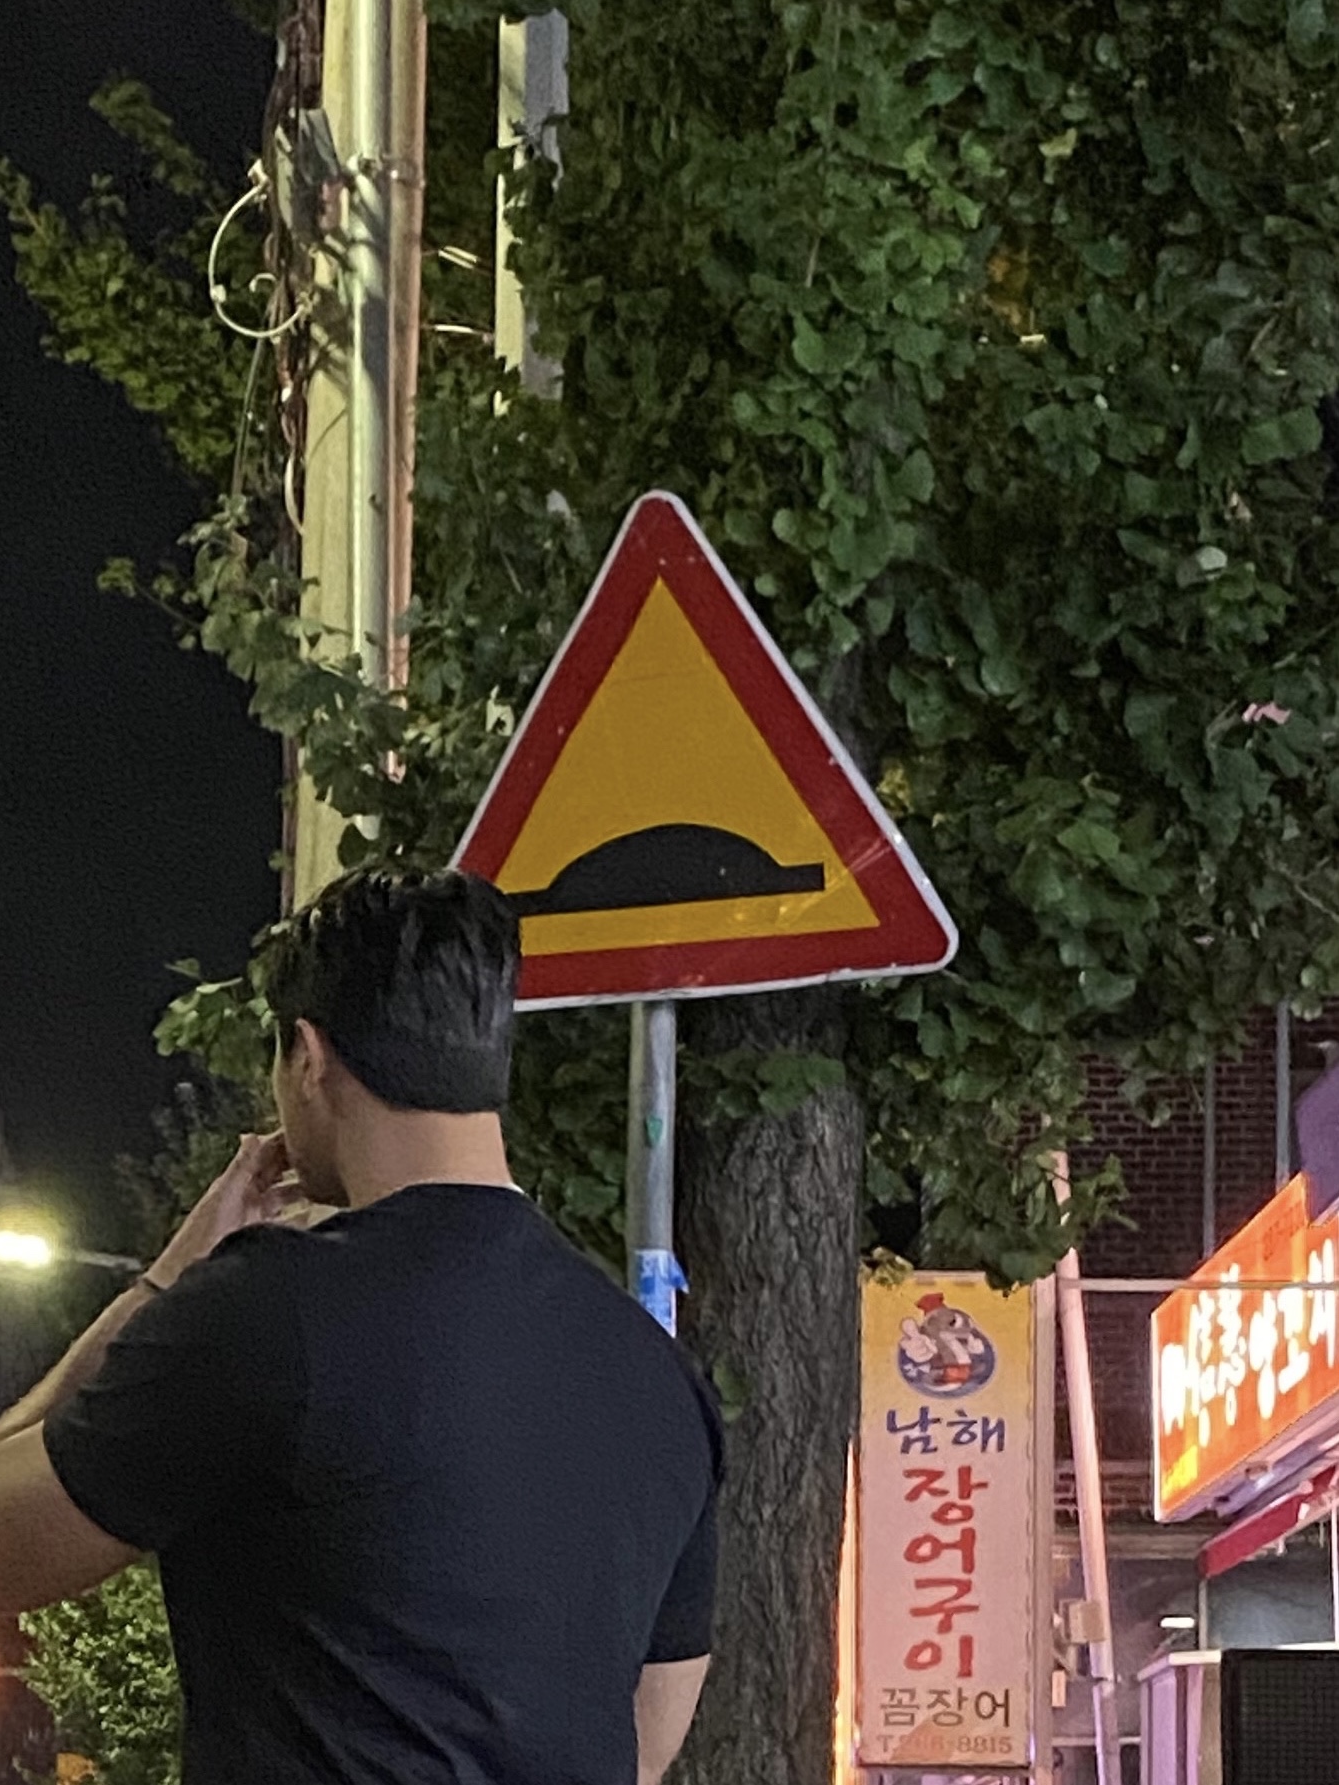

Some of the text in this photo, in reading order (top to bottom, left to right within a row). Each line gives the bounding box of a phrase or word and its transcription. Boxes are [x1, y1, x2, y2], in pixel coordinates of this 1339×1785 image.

[886, 1406, 1005, 1454] 남해
[903, 1465, 989, 1678] 장어구이
[880, 1687, 1010, 1728] 꼼장어
